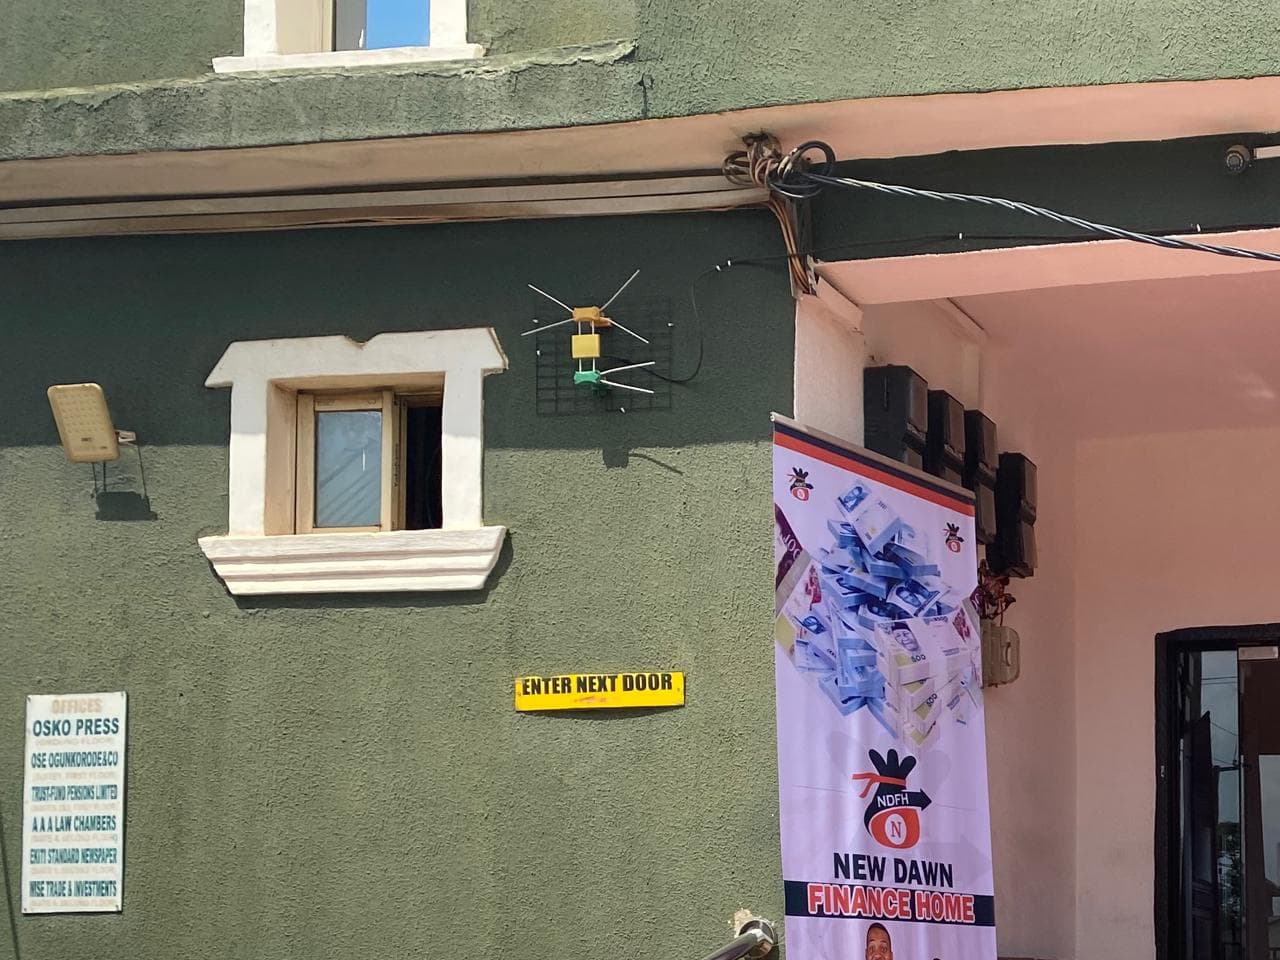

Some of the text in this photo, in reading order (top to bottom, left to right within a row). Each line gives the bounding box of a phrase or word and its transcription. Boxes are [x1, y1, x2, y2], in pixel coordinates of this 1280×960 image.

[522, 673, 673, 695] ENTER NEXT DOOR
[52, 698, 102, 714] OFFICES
[33, 717, 120, 737] OSKO PRESS
[31, 752, 47, 768] OSE
[877, 793, 909, 807] NDFH
[55, 816, 72, 831] LAW
[73, 815, 116, 831] CHAMBERS
[890, 820, 902, 838] N
[30, 848, 46, 864] EKITI
[81, 848, 117, 864] NEWSPAPER
[833, 852, 953, 888] NEW DAWN
[46, 880, 66, 897] TRADE
[74, 880, 117, 896] INVESTMENTS
[807, 883, 975, 923] FINANCE HOME
